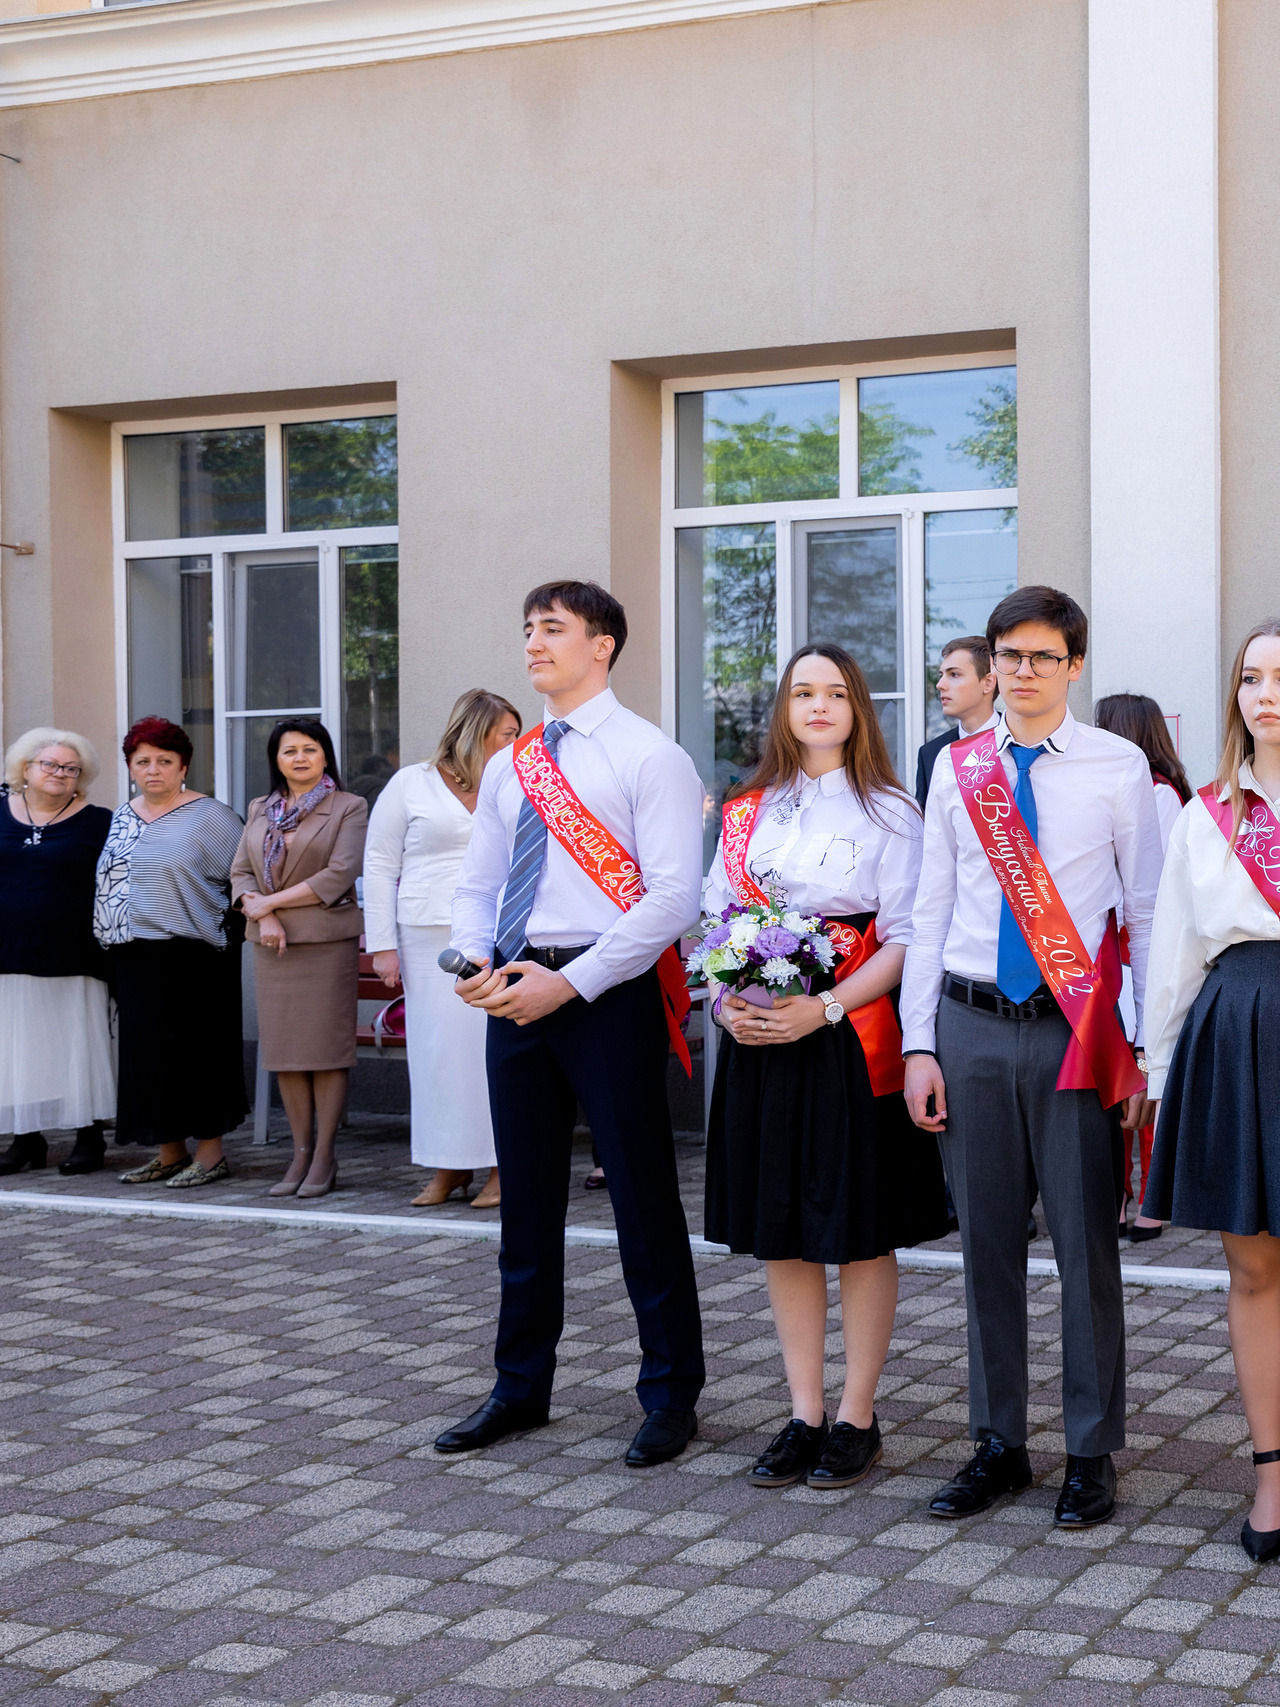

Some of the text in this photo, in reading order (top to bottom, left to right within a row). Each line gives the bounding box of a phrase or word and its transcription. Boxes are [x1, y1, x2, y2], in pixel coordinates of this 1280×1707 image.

[522, 754, 616, 875] Выпускник
[973, 783, 1093, 996] Выпускник 2022
